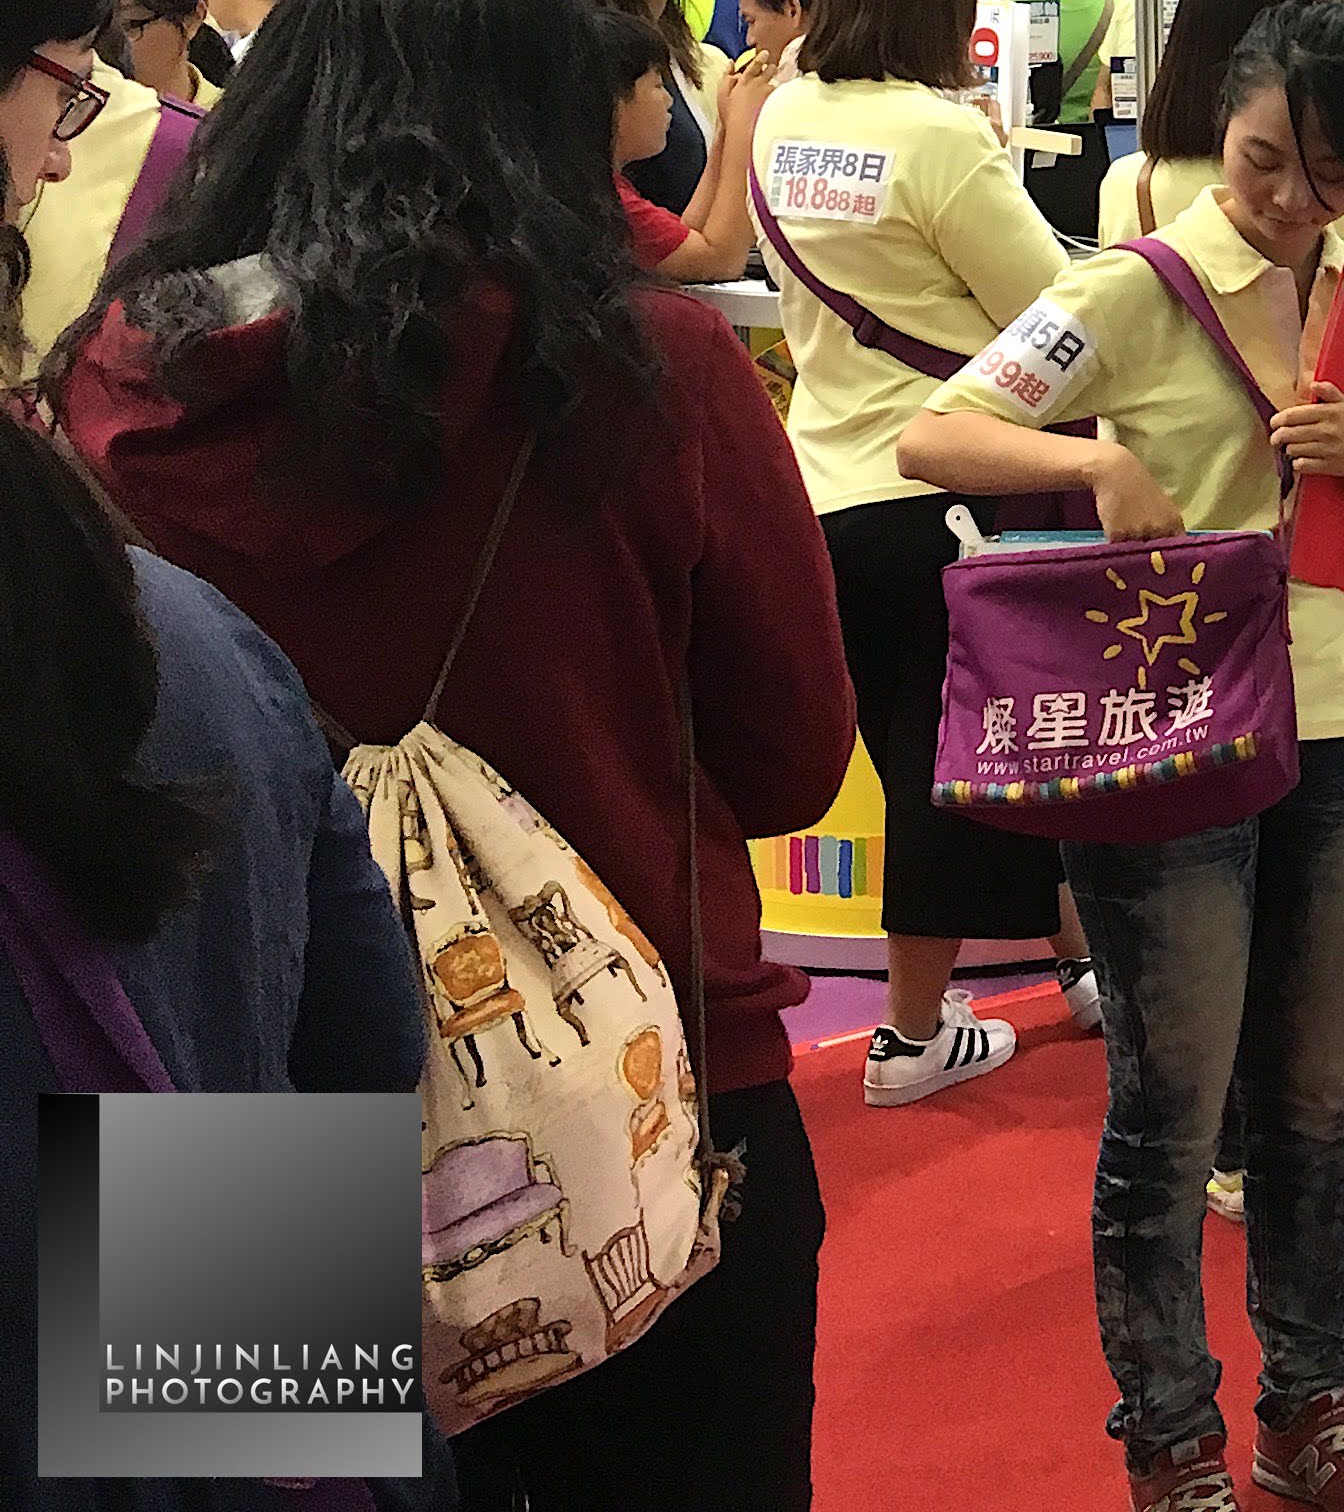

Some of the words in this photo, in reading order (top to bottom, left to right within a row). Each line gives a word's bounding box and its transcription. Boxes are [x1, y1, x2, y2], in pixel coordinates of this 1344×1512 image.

[774, 146, 886, 182] 張家界8日
[976, 675, 1214, 756] 燦星旅遊
